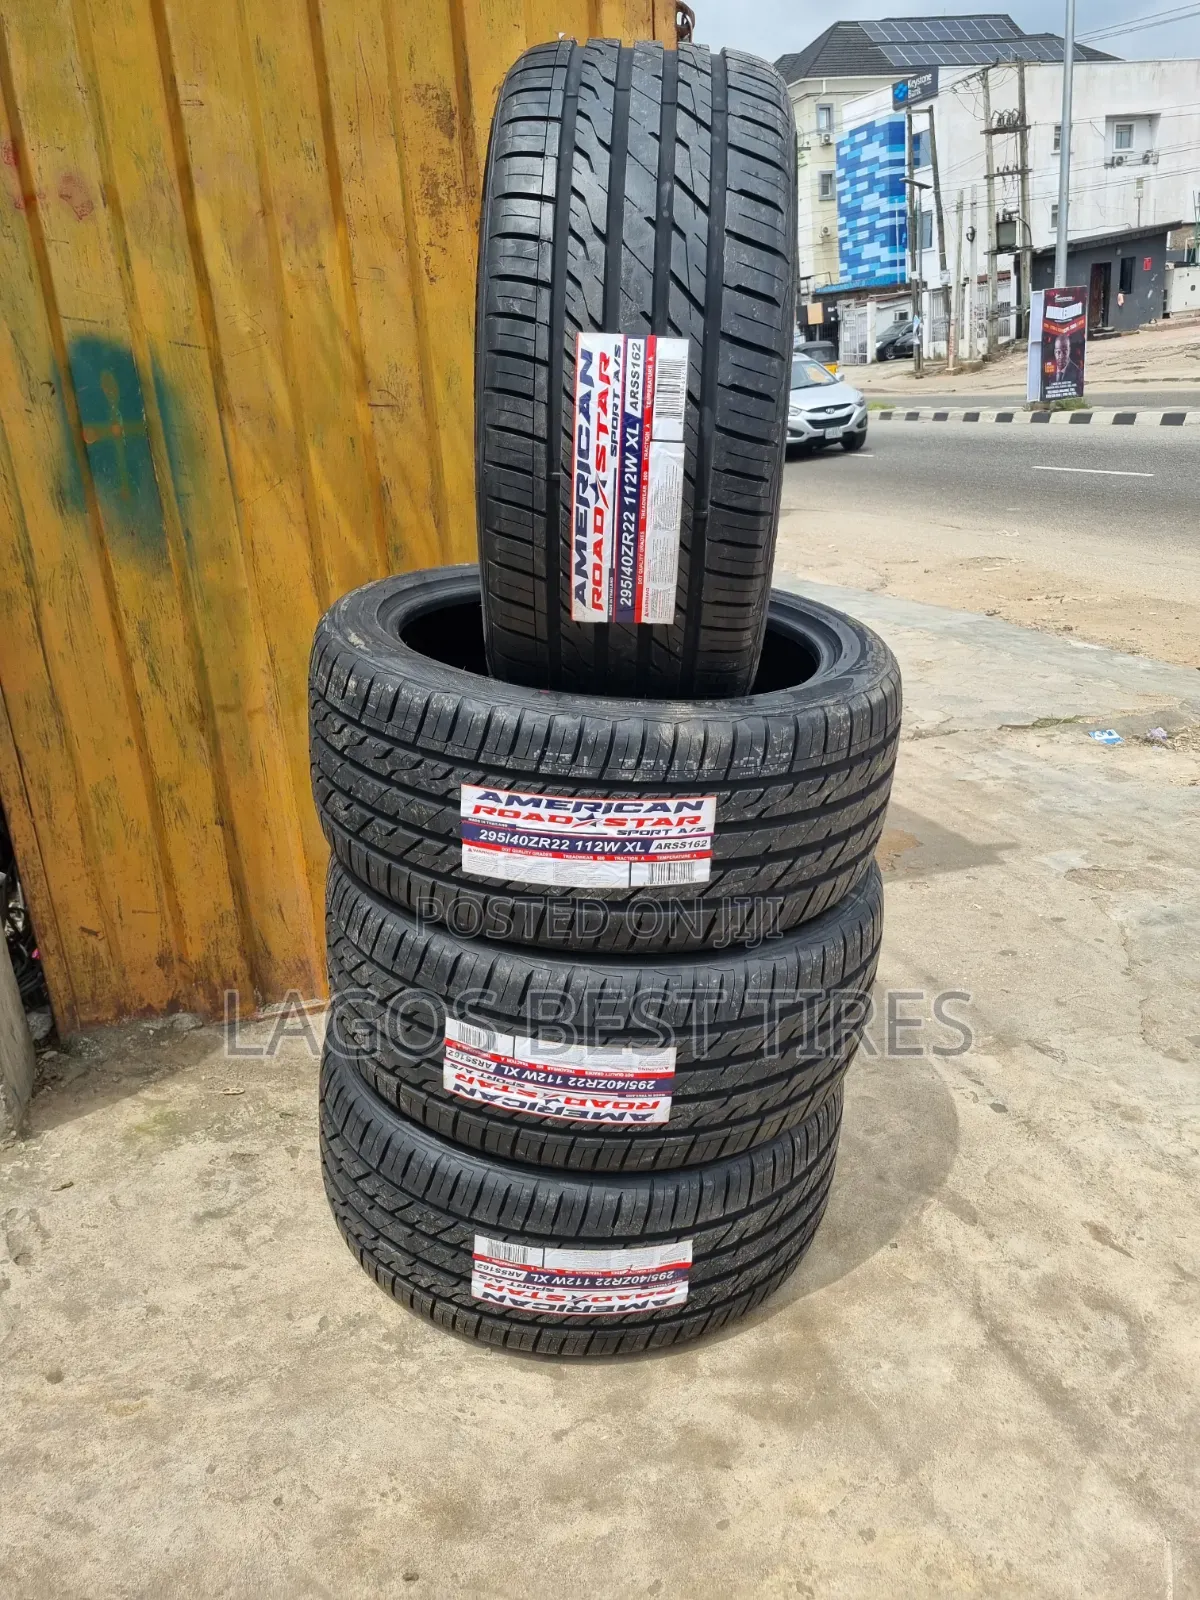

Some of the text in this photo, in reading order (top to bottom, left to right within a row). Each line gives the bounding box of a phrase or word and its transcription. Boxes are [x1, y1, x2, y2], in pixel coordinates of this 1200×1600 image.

[908, 73, 932, 88] Keystone
[630, 343, 641, 411] ARSS162
[611, 389, 619, 457] SPORT
[575, 348, 594, 607] AMERICAN
[592, 352, 610, 611] ROAD STAR
[620, 423, 639, 606] 295/40ZR22 112W XL
[477, 791, 704, 814] AMERICAN
[473, 805, 701, 828] ROAD STAR
[479, 830, 645, 852] 295/40ZR22 112W XL
[654, 840, 707, 850] ARSS162
[447, 1050, 491, 1068] ARSS162
[450, 1064, 525, 1088] SPORT A/S
[501, 1065, 656, 1089] 295/40ZR22 112W XL
[453, 1084, 654, 1121] AMERICAN
[455, 1073, 660, 1110] ROAD STAR
[477, 1264, 522, 1278] ARSS162
[531, 1271, 675, 1285] 295/40ZR22 112W XL
[479, 1275, 555, 1292] SPORT A/S
[484, 1283, 678, 1302] ROAD STAR
[482, 1292, 674, 1313] AMERICAN
